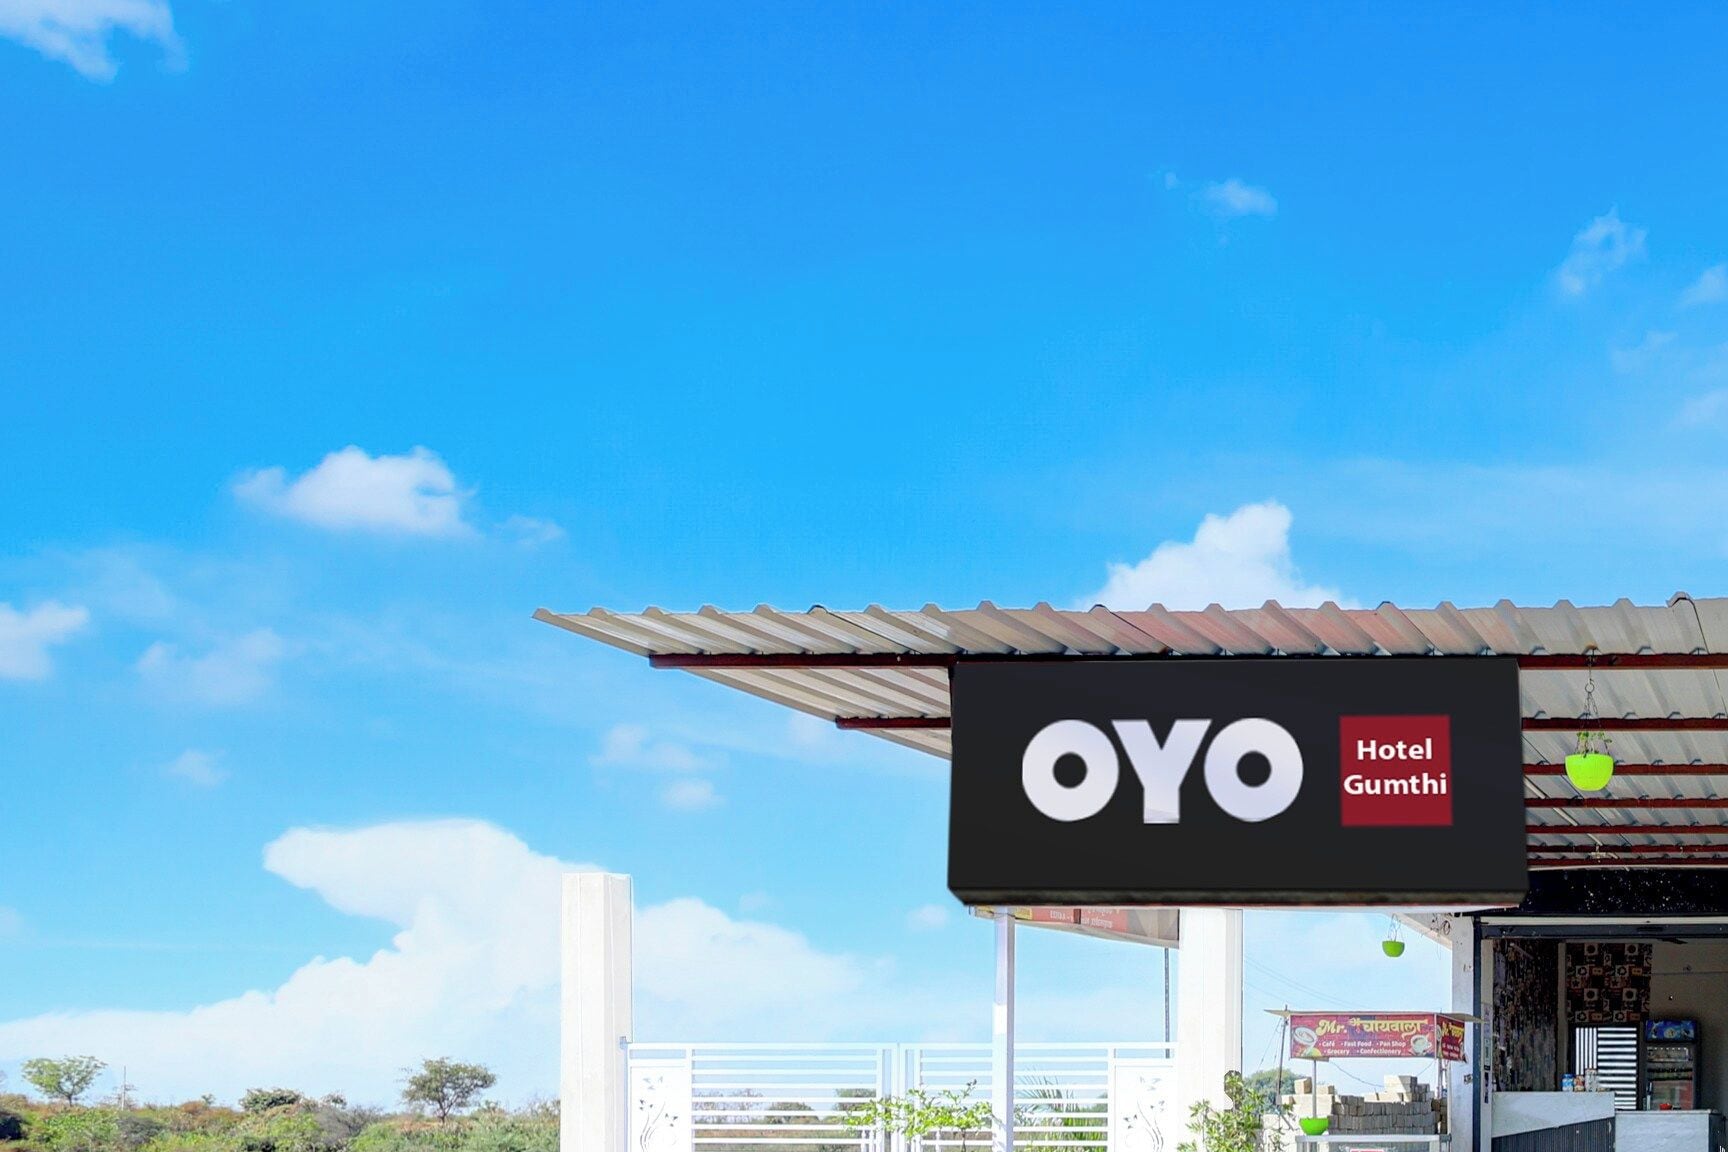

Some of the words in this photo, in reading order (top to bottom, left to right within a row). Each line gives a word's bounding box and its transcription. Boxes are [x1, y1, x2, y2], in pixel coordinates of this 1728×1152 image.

[1357, 738, 1433, 761] Hotel
[1022, 717, 1304, 824] OYO
[1343, 772, 1447, 795] Gumthi
[1316, 1019, 1347, 1036] Mr.
[1350, 1018, 1428, 1040] चायवाला
[1391, 1041, 1406, 1049] Shop
